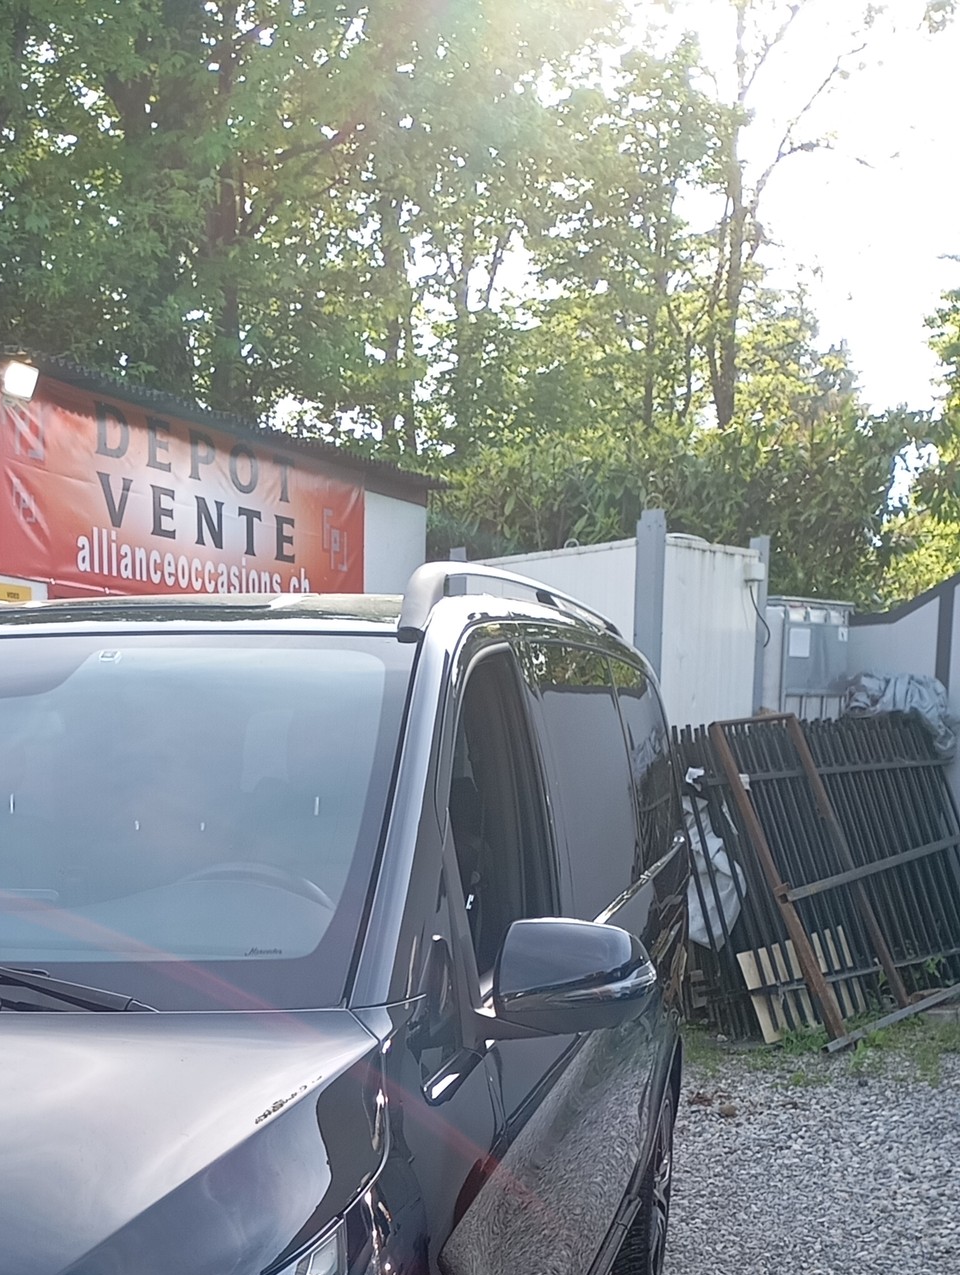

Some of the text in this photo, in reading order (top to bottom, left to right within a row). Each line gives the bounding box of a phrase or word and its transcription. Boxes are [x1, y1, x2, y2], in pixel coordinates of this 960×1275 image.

[95, 401, 295, 503] DEPOT
[76, 527, 310, 593] allianceoccasionsch
[96, 471, 296, 564] VENTE
